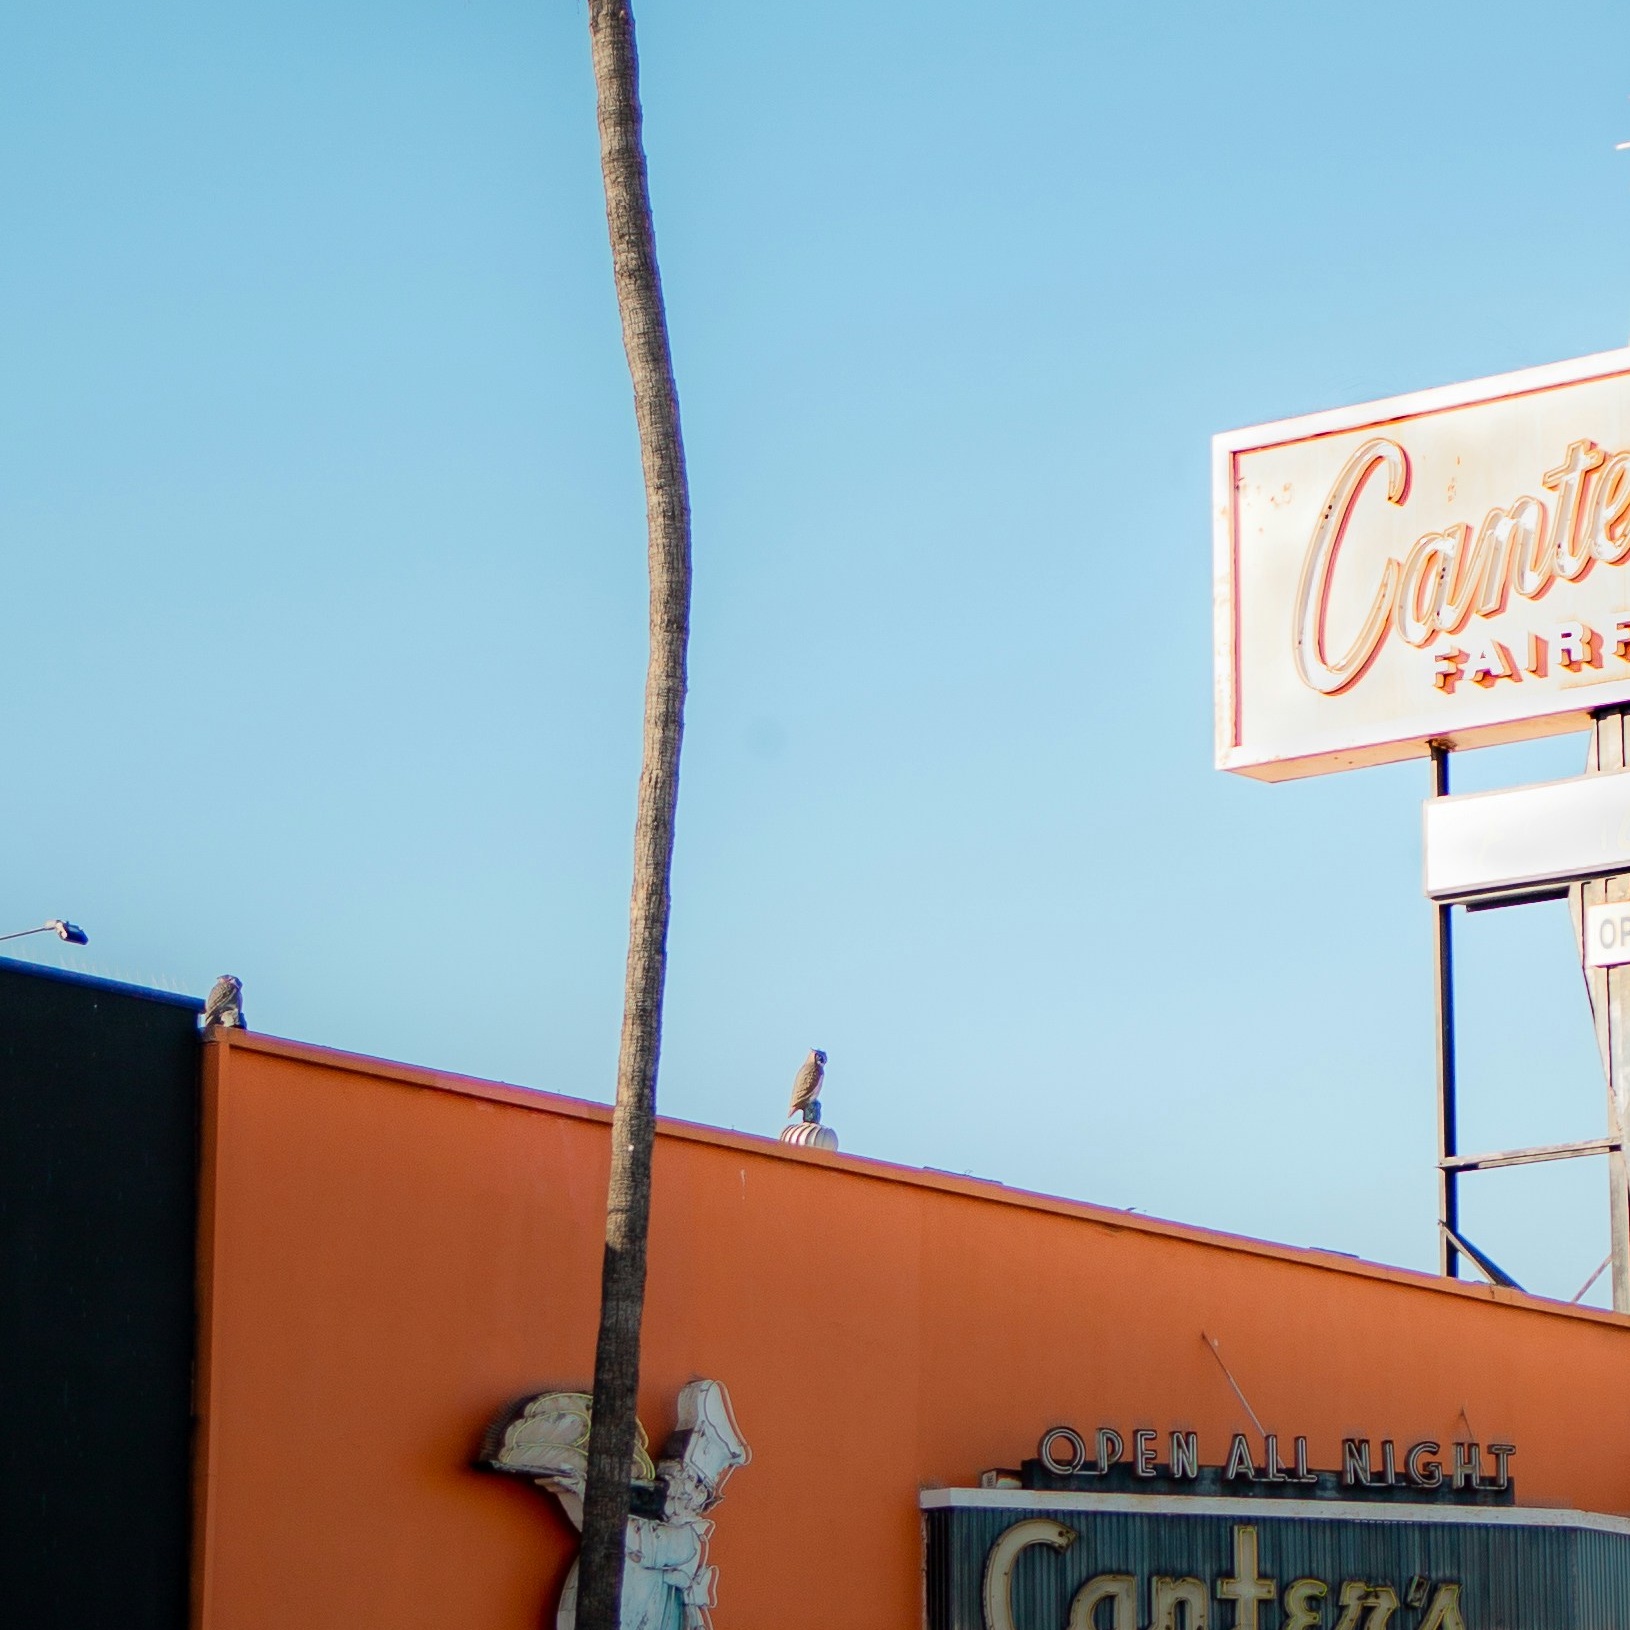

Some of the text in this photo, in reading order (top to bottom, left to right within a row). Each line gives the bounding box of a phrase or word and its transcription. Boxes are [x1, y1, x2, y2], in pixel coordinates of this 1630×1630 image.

[1038, 1427, 1517, 1490] OPEN ALL NIGHT
